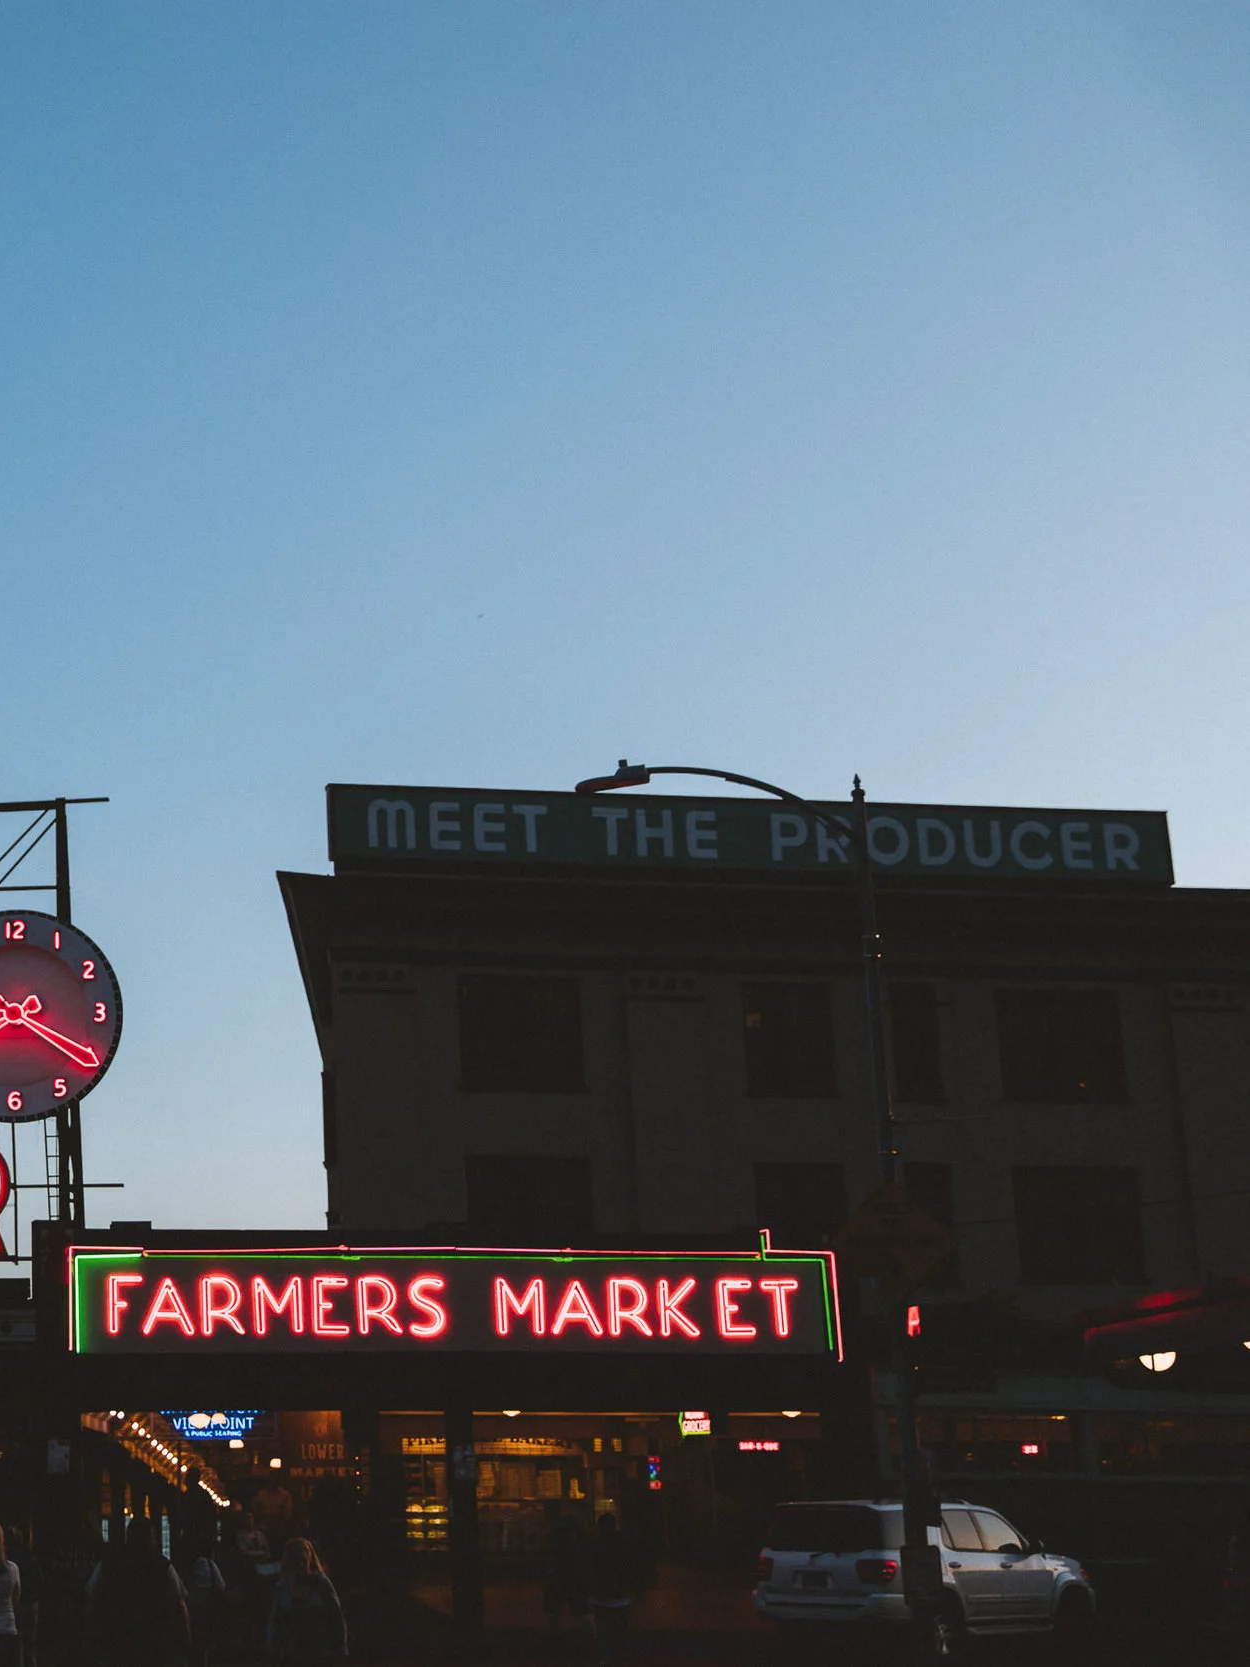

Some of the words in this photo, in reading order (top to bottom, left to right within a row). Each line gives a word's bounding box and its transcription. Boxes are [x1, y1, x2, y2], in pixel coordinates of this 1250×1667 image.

[367, 799, 548, 853] MEET
[591, 806, 718, 859] THE
[770, 813, 1140, 871] PRODUCER
[5, 921, 26, 939] 12
[53, 931, 61, 950] 1
[82, 960, 95, 979] 2
[94, 1002, 106, 1022] 3
[54, 1078, 67, 1097] 5
[7, 1091, 22, 1110] 6
[104, 1273, 449, 1339] FARMERS
[494, 1276, 800, 1340] MARKET
[300, 1443, 344, 1460] LOWER
